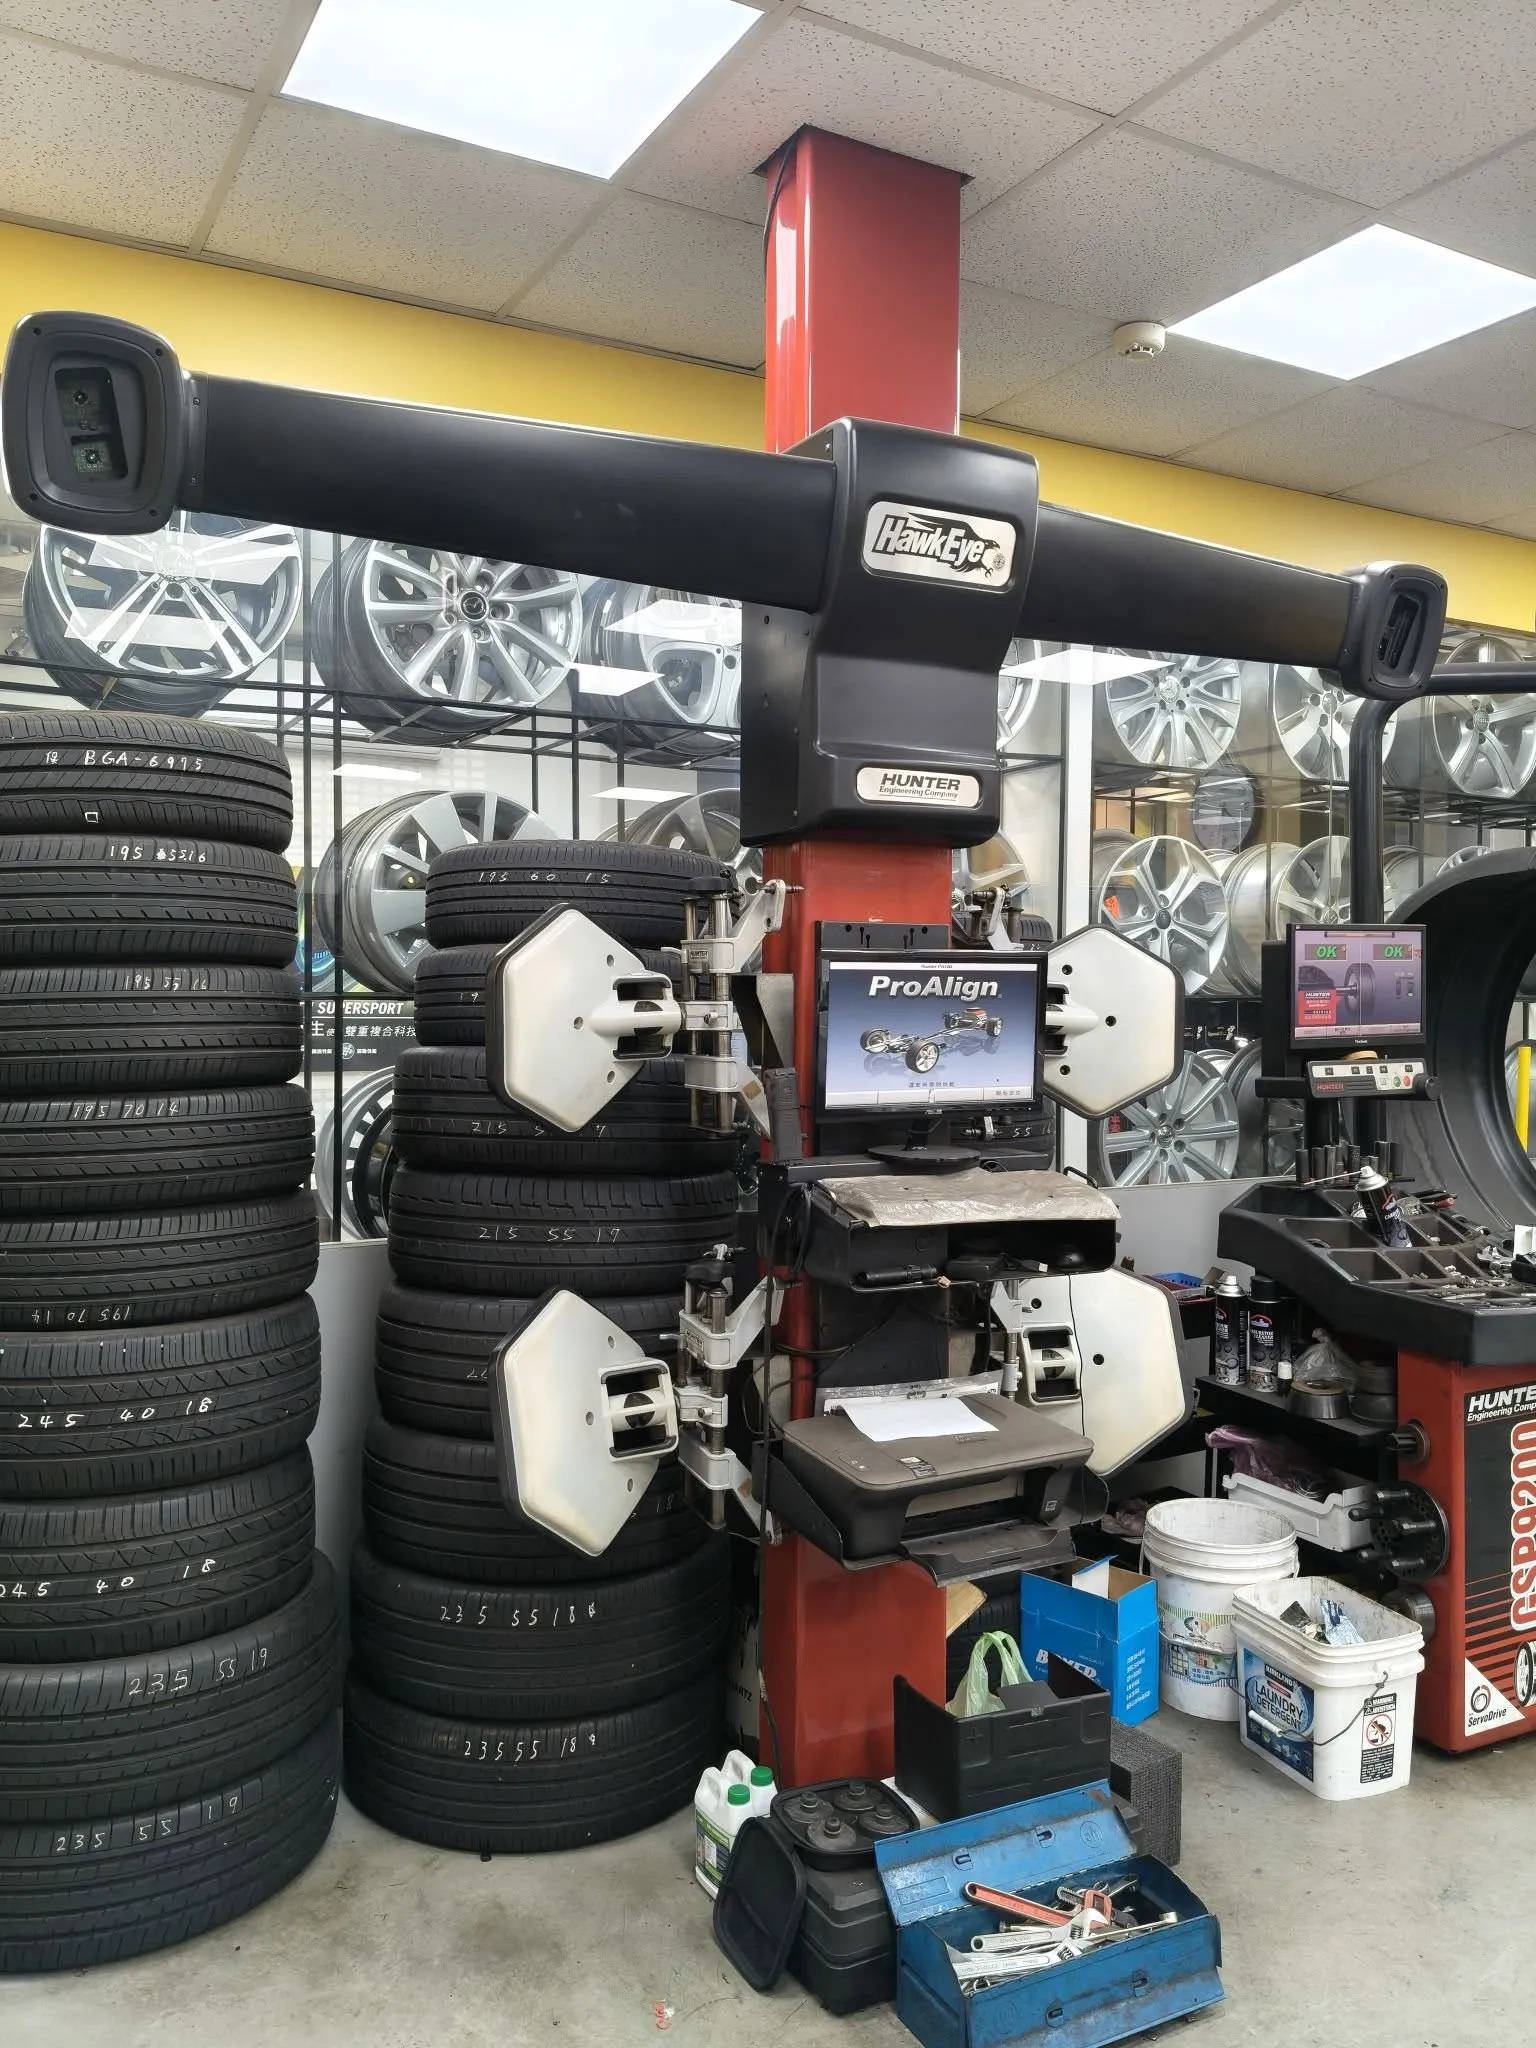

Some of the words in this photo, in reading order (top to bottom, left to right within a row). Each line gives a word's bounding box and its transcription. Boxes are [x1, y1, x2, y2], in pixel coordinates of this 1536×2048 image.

[875, 514, 985, 566] HawkEye
[881, 773, 961, 791] HUNTER
[879, 785, 923, 797] Engineering
[924, 789, 958, 799] Company
[111, 845, 143, 860] 195
[530, 872, 556, 881] 60
[585, 873, 610, 884] 15
[1316, 945, 1337, 958] OK
[1384, 945, 1404, 958] OK
[868, 975, 999, 1002] ProAlign
[317, 1001, 404, 1015] SUERSPORT
[74, 1105, 109, 1120] 195
[124, 1104, 145, 1118] 70
[157, 1101, 179, 1116] 14
[480, 1225, 519, 1241] 215
[547, 1228, 576, 1242] 55
[597, 1227, 620, 1243] 17
[18, 1413, 85, 1428] 245
[120, 1408, 155, 1421] 40
[186, 1397, 212, 1415] 18
[1467, 1407, 1512, 1422] Engineering
[96, 1576, 134, 1593] 40
[183, 1559, 215, 1578] 18
[440, 1604, 488, 1625] 235
[511, 1608, 539, 1627] 55
[553, 1605, 576, 1627] 18
[128, 1670, 188, 1695] 235
[216, 1658, 237, 1682] 55
[251, 1651, 268, 1671] 19
[1255, 1679, 1304, 1720] LAUNDRY
[1256, 1694, 1302, 1729] DETERGENT
[1468, 1708, 1507, 1727] ServoDrive
[560, 1736, 577, 1758] 18
[57, 1832, 105, 1852] 235
[138, 1819, 172, 1841] 55
[208, 1796, 238, 1819] 19
